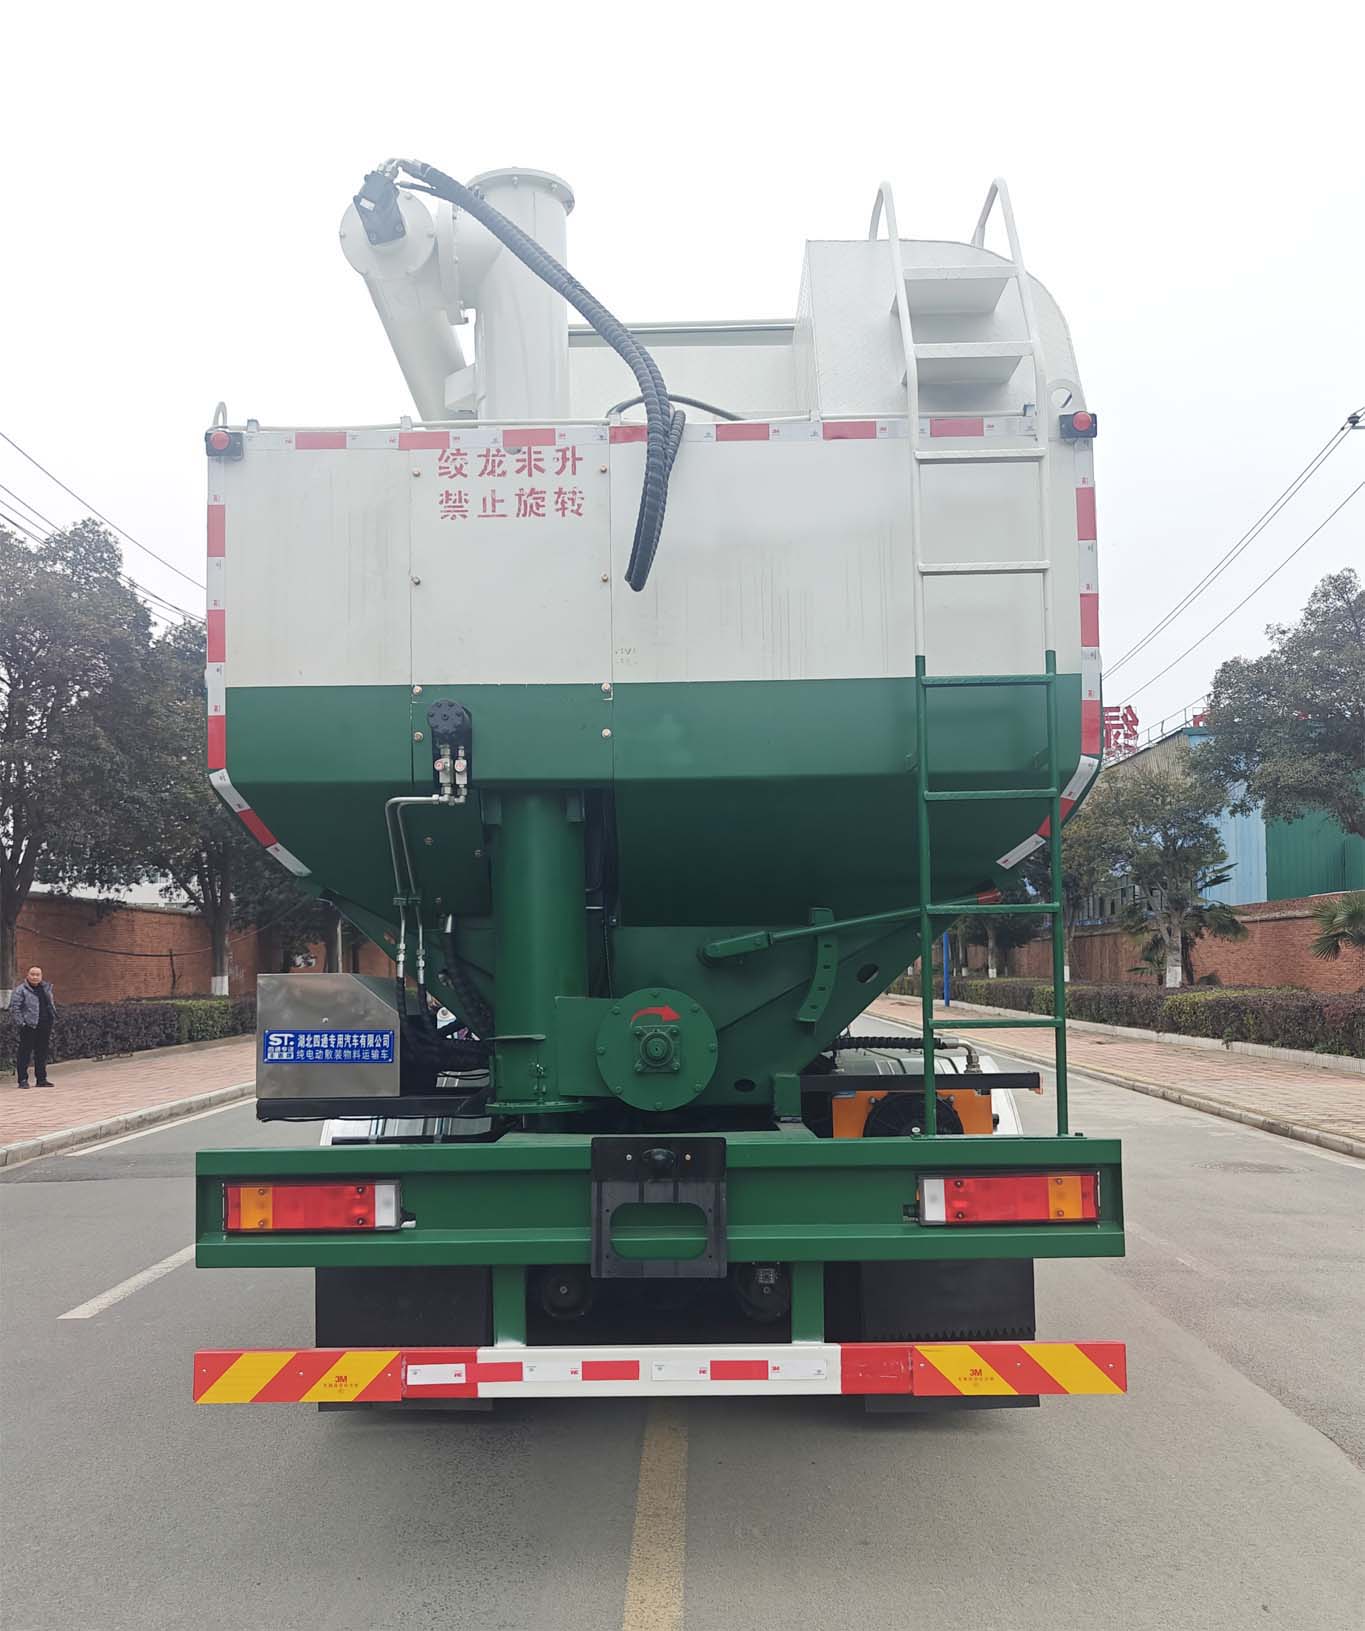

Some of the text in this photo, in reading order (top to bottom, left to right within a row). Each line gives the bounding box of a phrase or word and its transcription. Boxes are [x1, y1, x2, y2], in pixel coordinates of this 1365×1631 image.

[437, 445, 584, 479] 绞龙未升
[438, 486, 585, 521] 禁止旋转
[335, 1375, 348, 1383] 3M
[969, 1368, 983, 1377] 3M
